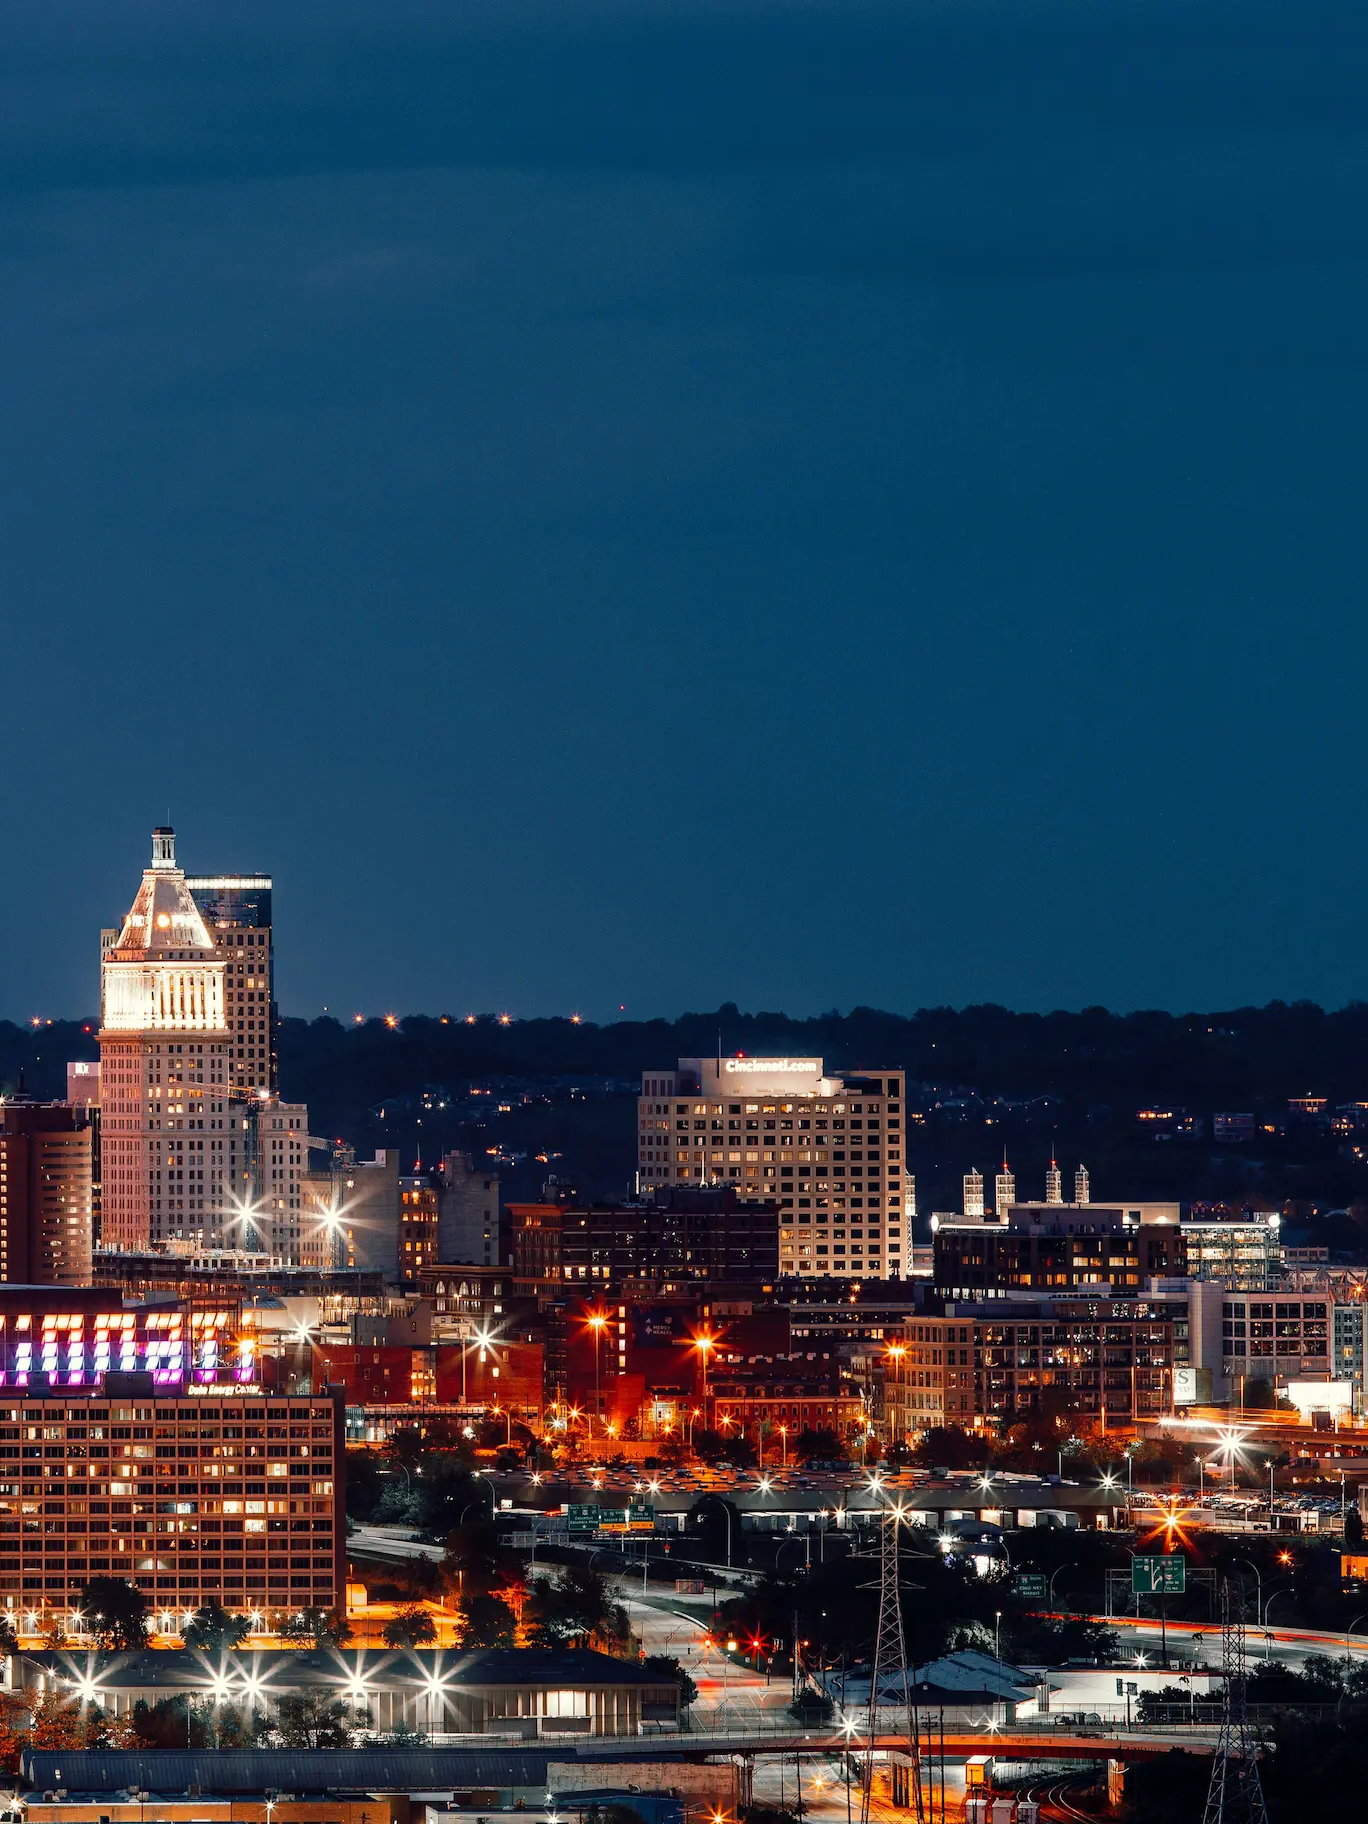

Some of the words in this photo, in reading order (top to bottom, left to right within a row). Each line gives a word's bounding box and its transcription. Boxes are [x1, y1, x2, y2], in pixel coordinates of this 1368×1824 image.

[725, 1060, 817, 1072] Cincinnati.com
[208, 1384, 234, 1396] Energy
[235, 1384, 260, 1394] Center
